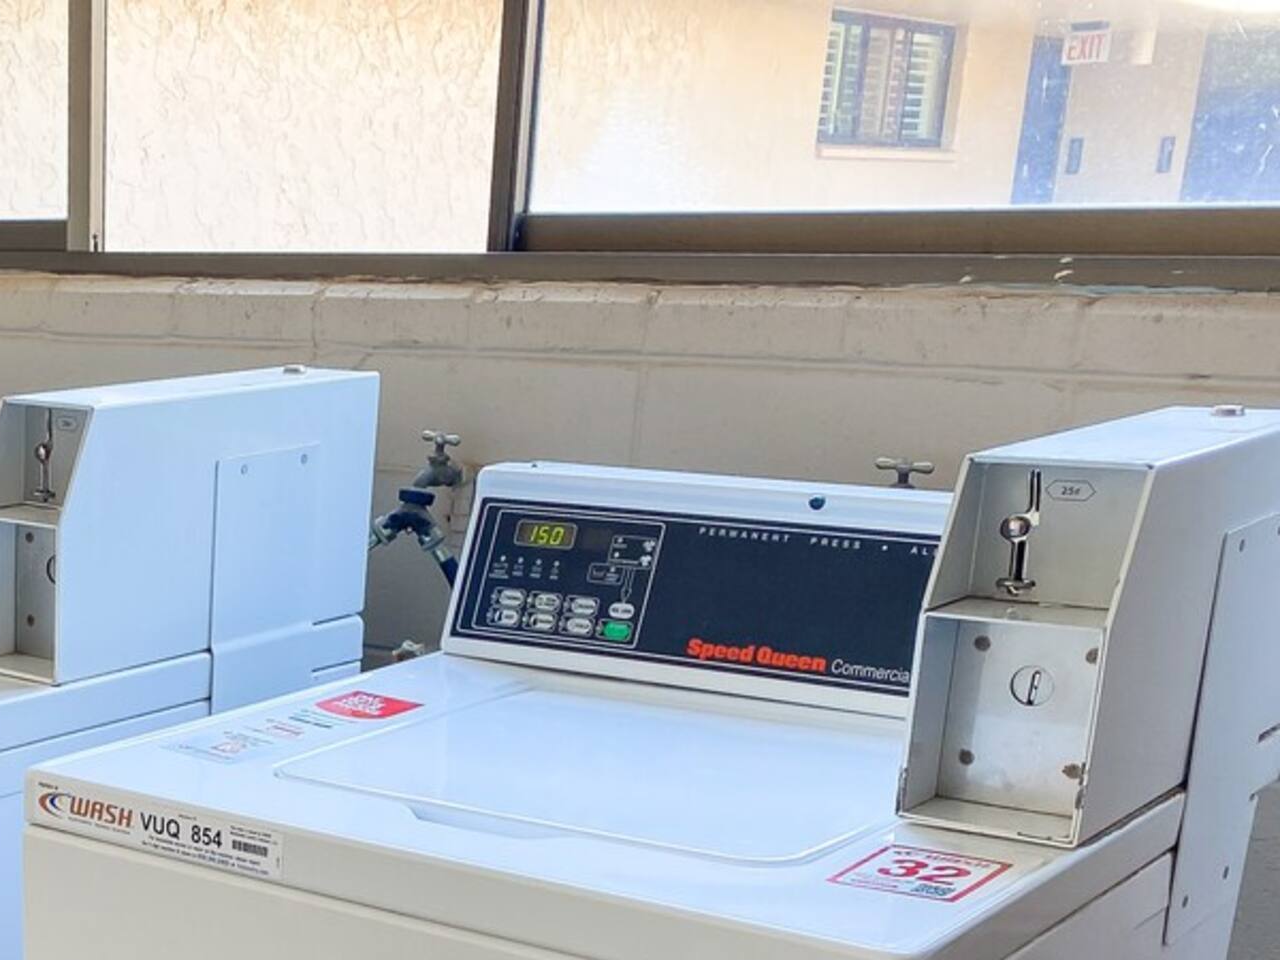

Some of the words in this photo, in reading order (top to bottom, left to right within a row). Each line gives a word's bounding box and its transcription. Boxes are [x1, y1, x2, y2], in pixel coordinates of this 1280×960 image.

[1066, 33, 1105, 61] EXIT
[528, 525, 565, 546] 150
[698, 526, 790, 543] PERMANENT
[809, 536, 861, 550] PRESS
[687, 637, 755, 661] Speed
[756, 645, 827, 673] Queen
[830, 657, 910, 684] Commercia
[69, 796, 132, 828] WASH
[140, 811, 181, 840] VUQ
[190, 824, 223, 848] 854
[877, 859, 971, 886] 32
